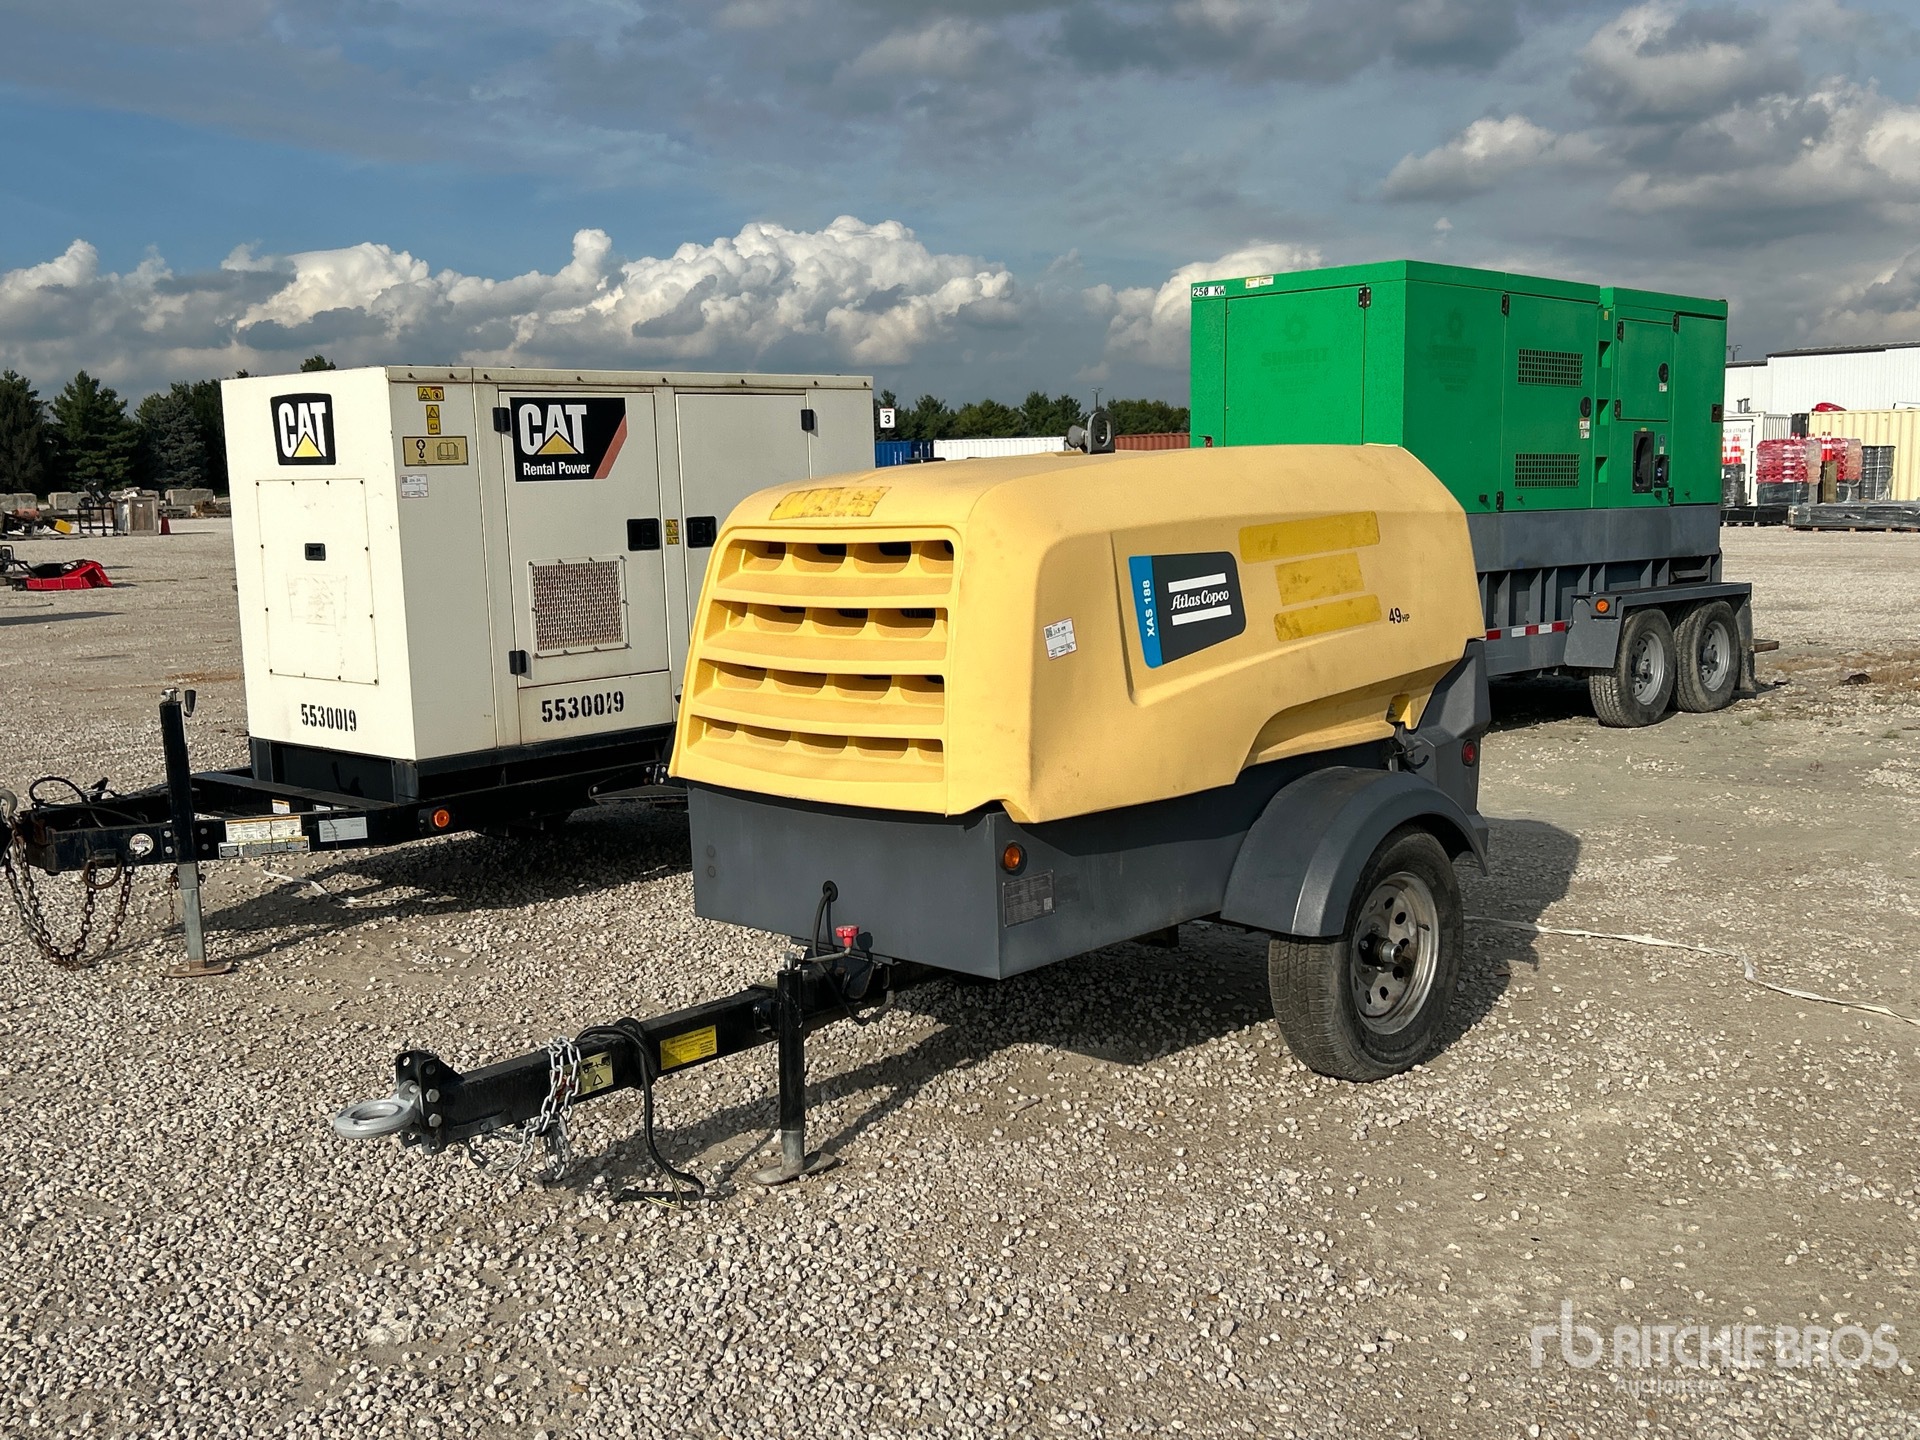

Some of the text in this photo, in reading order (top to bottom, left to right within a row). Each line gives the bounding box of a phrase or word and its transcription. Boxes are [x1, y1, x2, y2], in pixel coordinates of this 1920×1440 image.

[1193, 286, 1209, 297] 250
[278, 401, 327, 458] CAT
[518, 403, 587, 456] CAT
[884, 414, 891, 424] 3
[522, 461, 590, 476] Rental Power
[1142, 579, 1155, 637] XAS 188
[1170, 589, 1229, 610] Atlas Copco
[301, 703, 357, 732] 5530019
[541, 690, 624, 723] 5530019
